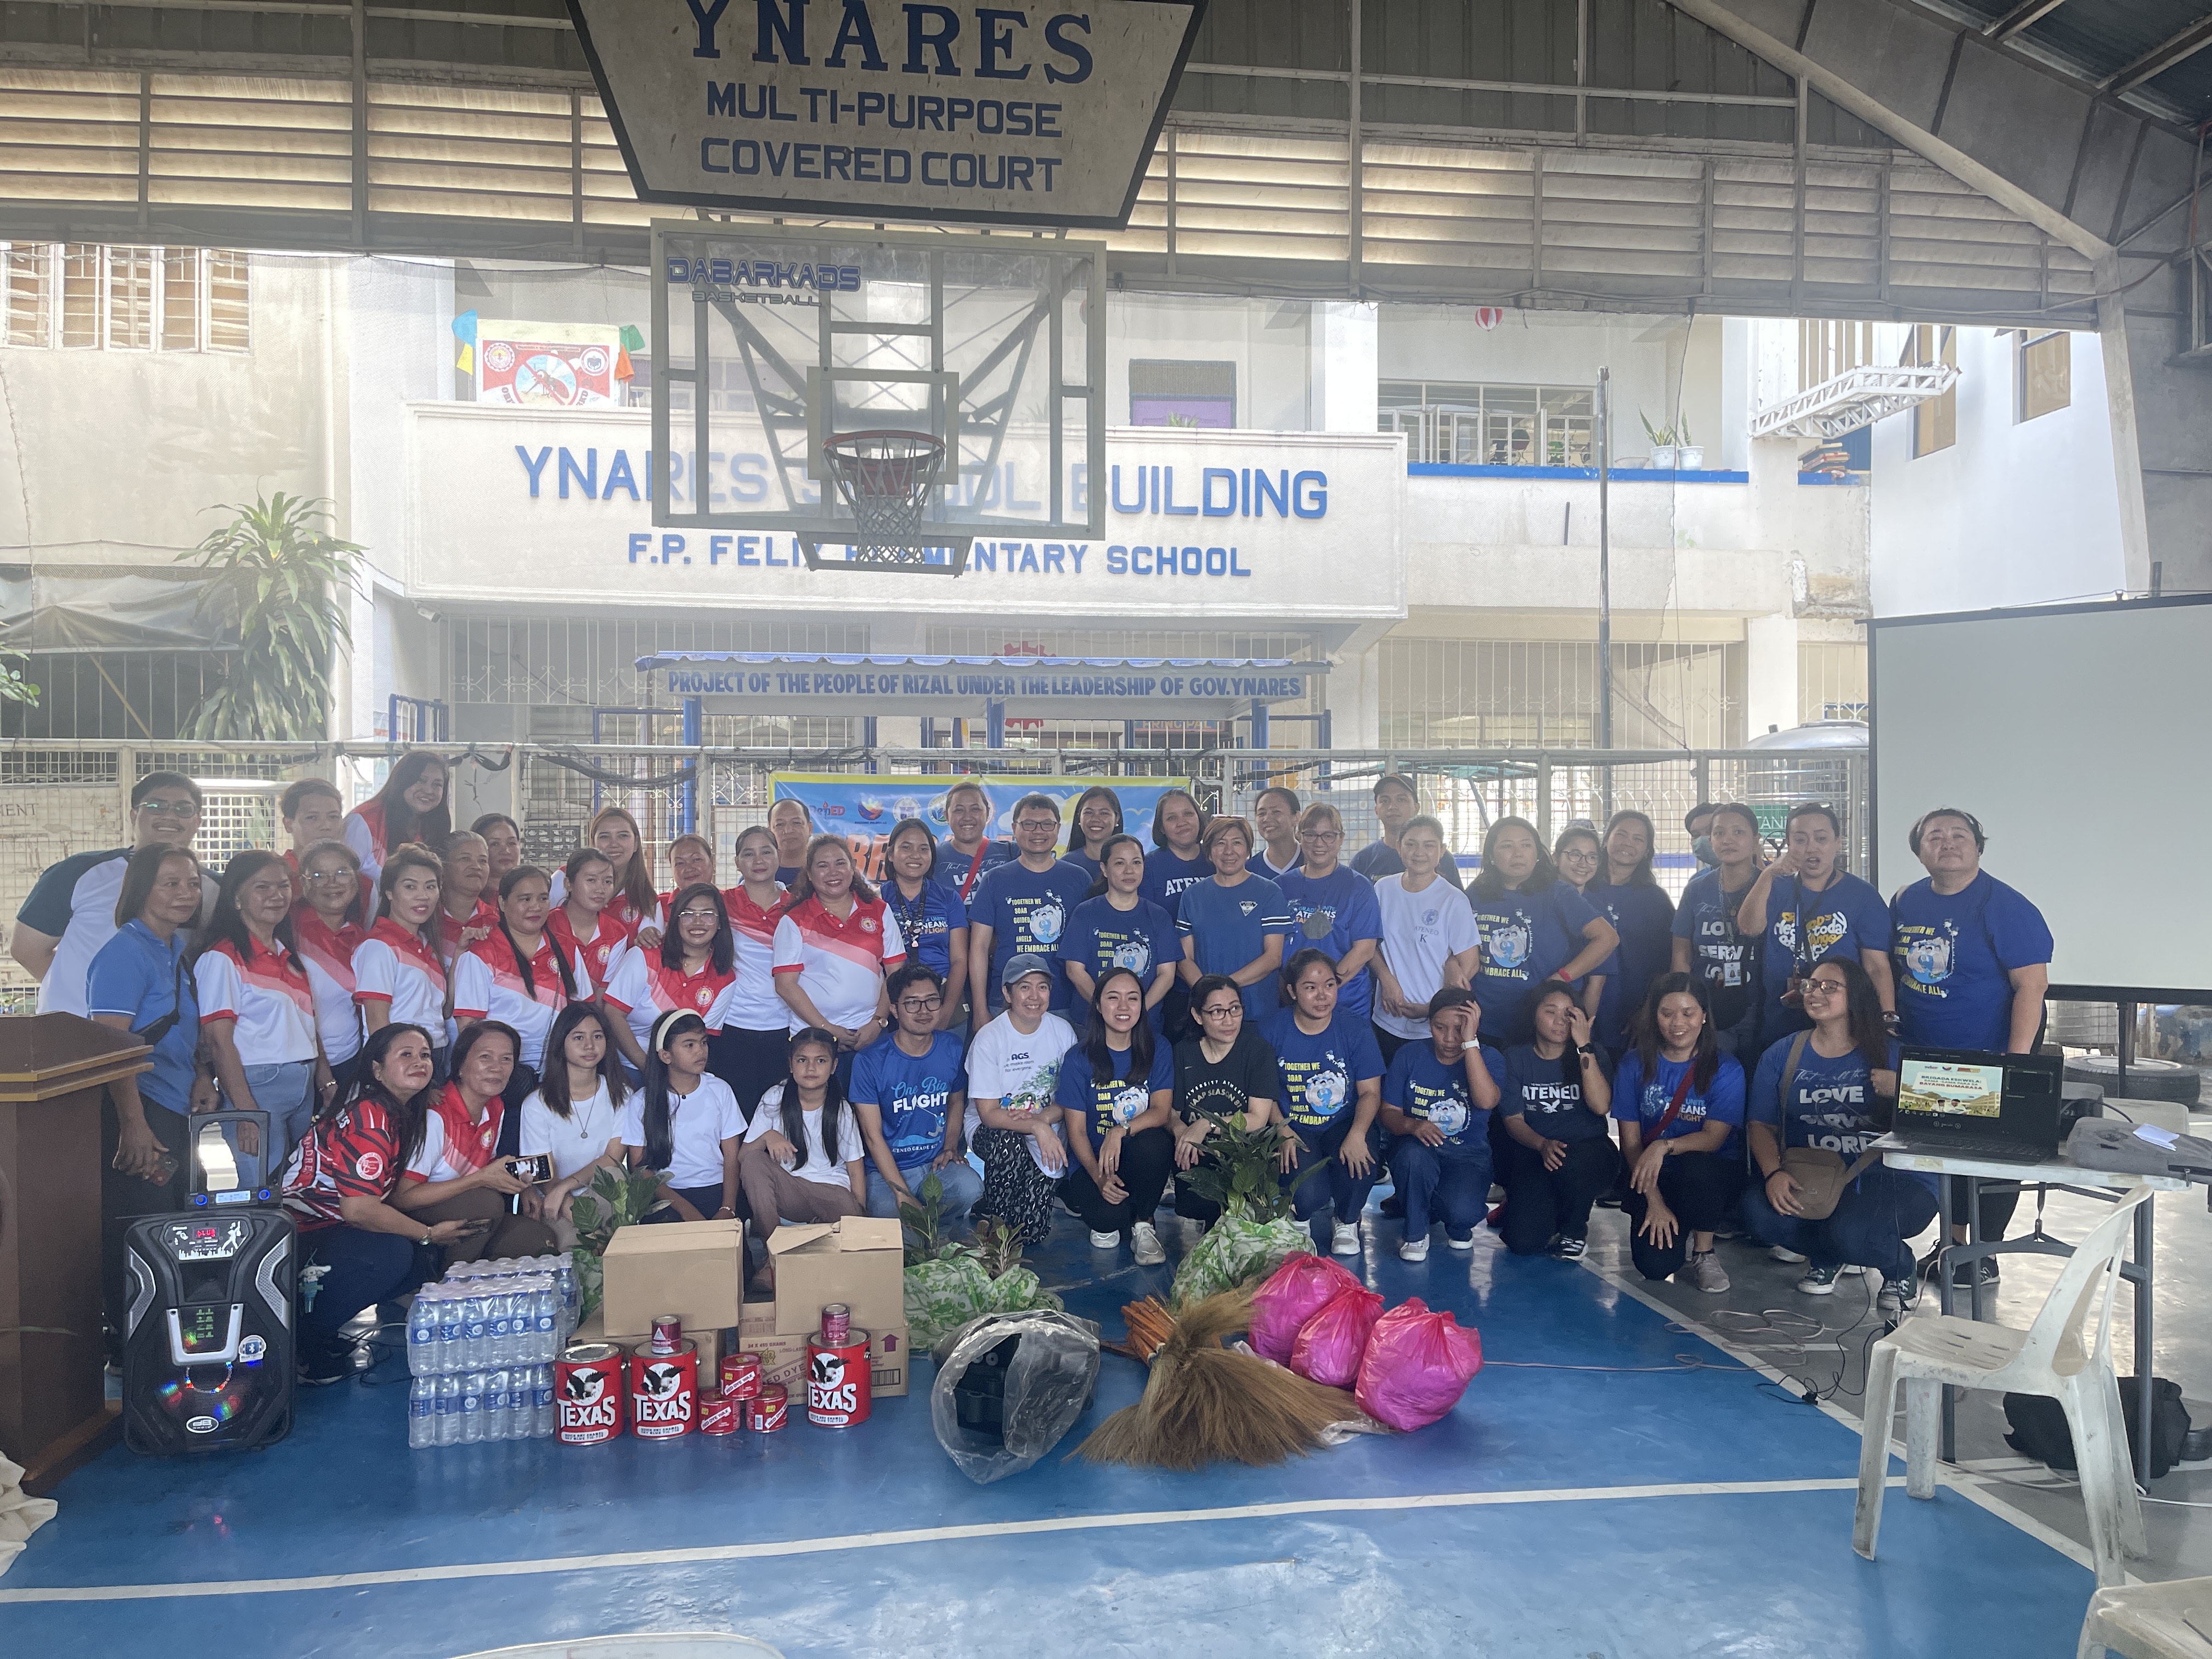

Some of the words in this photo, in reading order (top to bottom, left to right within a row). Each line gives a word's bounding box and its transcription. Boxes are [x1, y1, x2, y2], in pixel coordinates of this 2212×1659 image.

[687, 0, 1093, 85] YNARES
[707, 81, 1063, 138] MULTI-PURPOSE
[701, 138, 911, 184] COVERED
[921, 150, 1063, 192] COURT
[668, 258, 861, 291] DABARKADS
[692, 291, 822, 307] BASKETBALL
[515, 445, 768, 502] YNARES
[628, 533, 691, 565] F.P.
[1107, 545, 1251, 576] SCHOOL
[669, 672, 746, 693] PROJECT
[749, 673, 770, 692] OF
[776, 673, 810, 693] THE
[814, 674, 876, 694] PEOPLE
[879, 674, 899, 694] OF
[902, 675, 953, 694] RIZAL
[957, 675, 1015, 695] UNDER
[1022, 676, 1048, 695] THE
[1052, 676, 1155, 696] LEADERSHIP
[1161, 677, 1184, 696] OF
[1143, 720, 1212, 729] PRINCPAL
[1098, 932, 1120, 940] TOGETHER
[1024, 944, 1050, 952] EMBRACE
[1284, 1062, 1311, 1071] TOGETHER
[1311, 1062, 1321, 1070] WE
[1287, 1074, 1303, 1082] SOAR
[891, 1081, 919, 1099] One
[921, 1076, 947, 1094] Big
[1207, 1088, 1235, 1103] SEASON
[1522, 1084, 1580, 1101] ATENEO
[1799, 1086, 1865, 1104] LOVE
[893, 1091, 949, 1114] FLIGHT
[1097, 1092, 1111, 1101] SOAR
[1096, 1103, 1114, 1111] GUIDED
[733, 1380, 742, 1389] DYE
[557, 1395, 616, 1429] TEXAS
[633, 1390, 691, 1424] TEXAS
[709, 1415, 718, 1424] DYE
